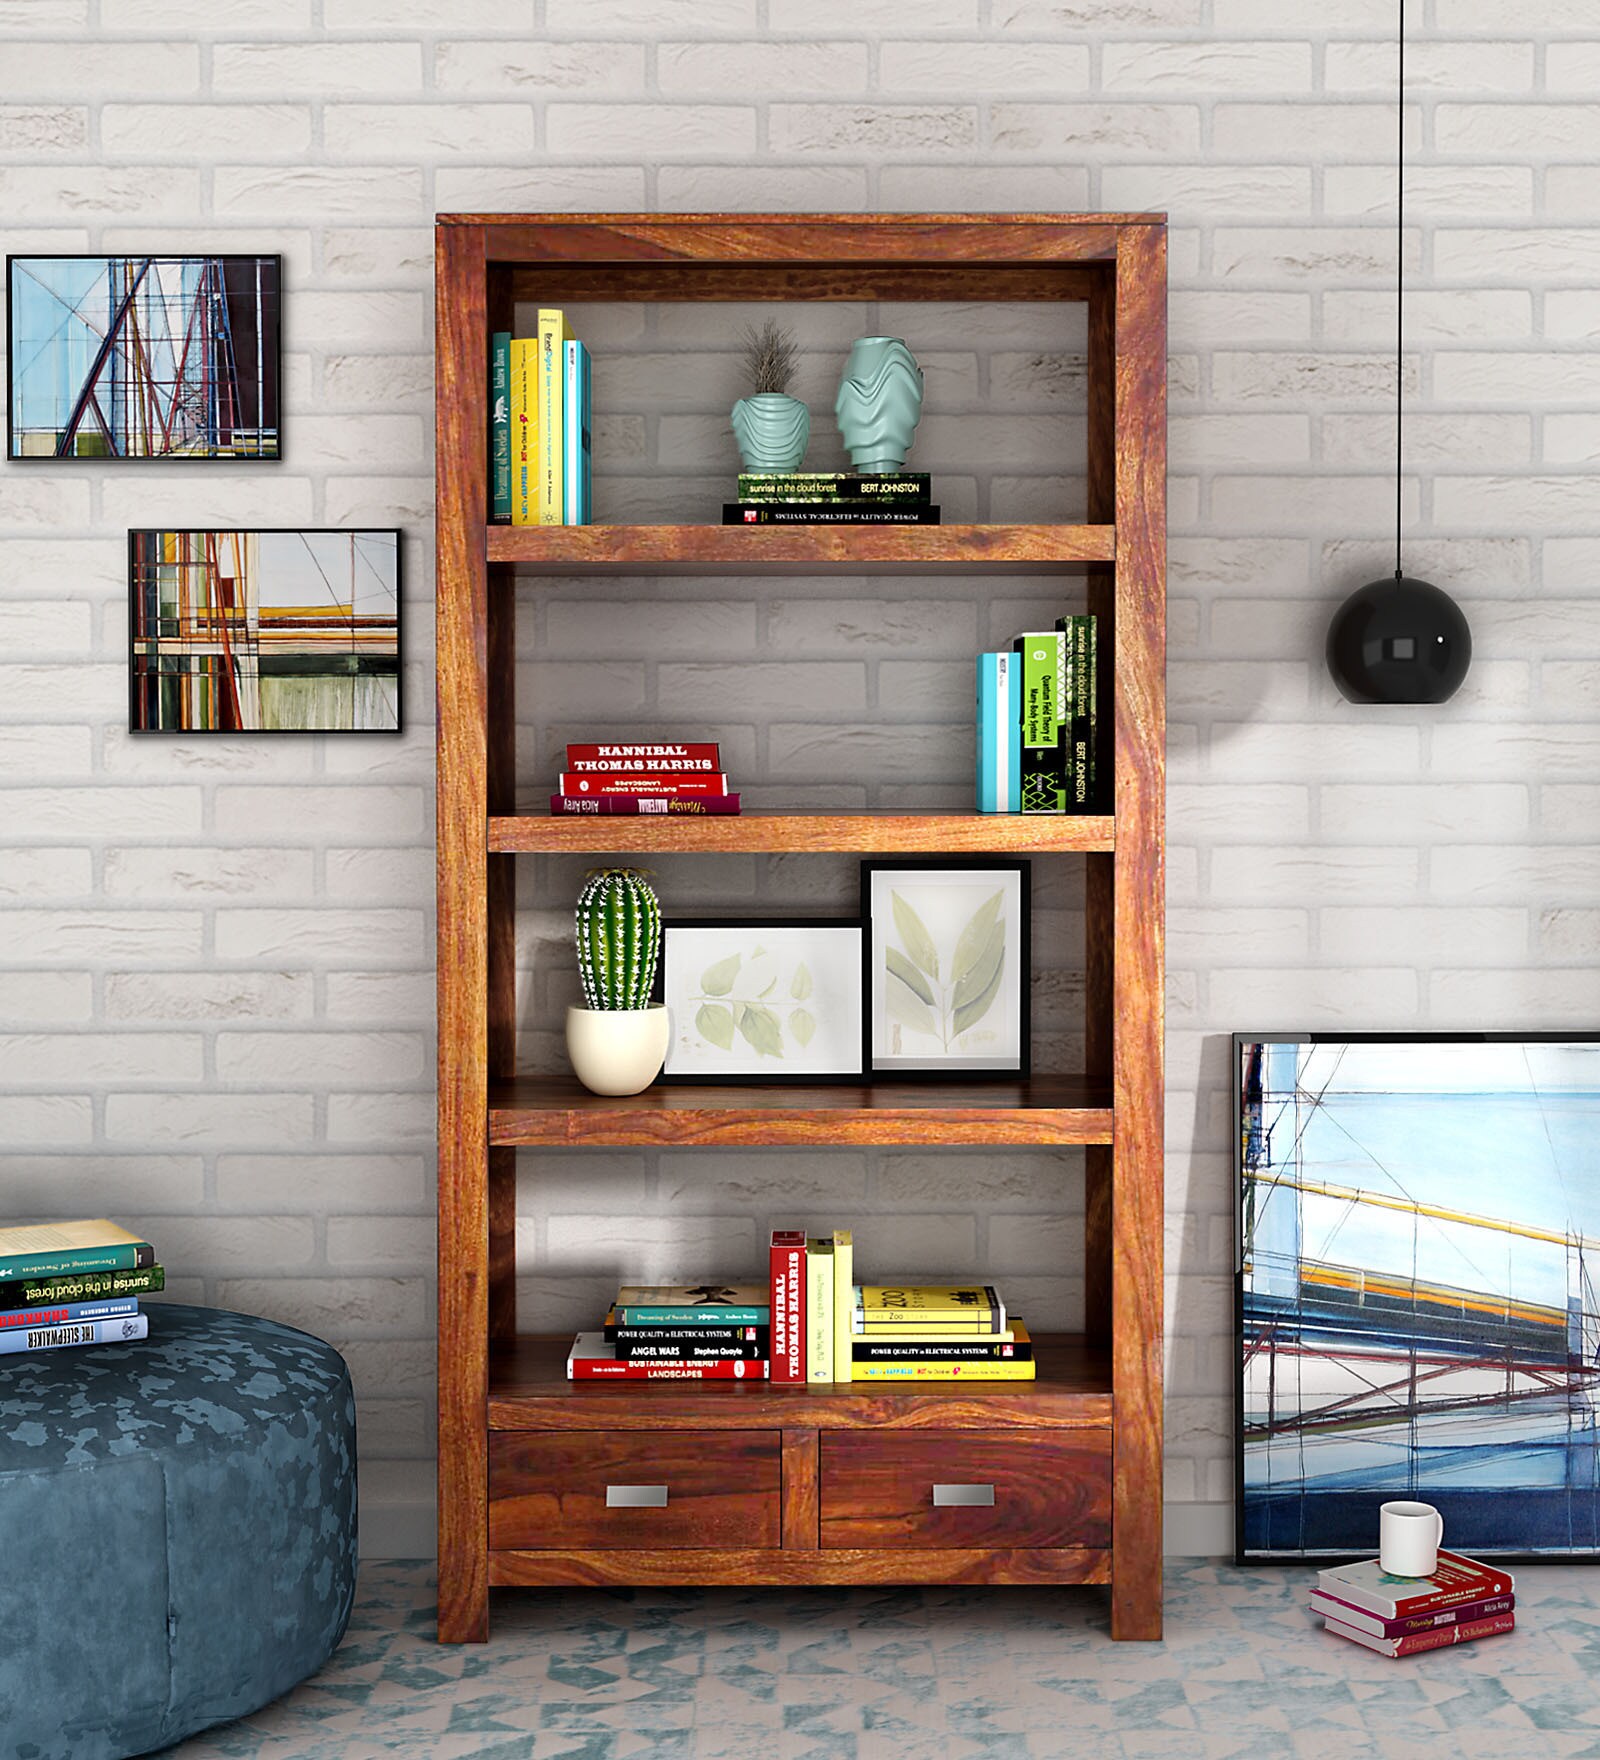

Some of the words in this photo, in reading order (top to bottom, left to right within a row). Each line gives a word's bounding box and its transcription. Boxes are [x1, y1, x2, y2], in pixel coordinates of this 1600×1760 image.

[494, 348, 505, 367] Brown
[494, 367, 505, 390] Andrew
[494, 429, 509, 457] Sweden
[494, 465, 511, 501] Dreaming
[749, 483, 776, 493] sunrise
[777, 482, 784, 493] in
[784, 482, 795, 493] the
[796, 482, 815, 493] cloud
[816, 482, 837, 493] forest
[860, 483, 879, 493] BERT
[879, 483, 920, 493] JOHNSTON
[860, 512, 892, 521] QUALITY
[1077, 626, 1086, 653] sunrise
[1078, 661, 1087, 674] the
[1041, 675, 1052, 701] Quantum
[1078, 675, 1087, 694] cloud
[1042, 701, 1052, 715] Field
[1077, 695, 1087, 717] forest
[1028, 719, 1040, 743] Systems
[1040, 716, 1052, 735] Theory
[598, 746, 688, 757] HANNIBAL
[1076, 741, 1086, 760] BERT
[574, 760, 645, 771] THOMAS
[646, 759, 713, 770] HARRIS
[1076, 760, 1086, 802] JOHNSTON
[563, 798, 581, 813] Airey
[581, 800, 600, 813] Alicia
[22, 1264, 59, 1273] Sweden
[71, 1258, 117, 1268] Dreaming
[85, 1283, 101, 1294] the
[102, 1281, 112, 1292] in
[113, 1276, 149, 1290] sunrise
[788, 1252, 799, 1312] HARRIS
[26, 1287, 55, 1301] forest
[55, 1284, 84, 1298] cloud
[882, 1290, 907, 1307] ZOO
[776, 1273, 786, 1355] HANNIBAL
[889, 1312, 904, 1320] Zoo
[27, 1326, 79, 1349] SLEEPWALKER
[81, 1325, 95, 1343] THE
[617, 1330, 638, 1338] POWER
[638, 1330, 664, 1339] QUALITY
[670, 1330, 705, 1338] ELECTRICAL
[706, 1330, 732, 1338] SYSTEMS
[631, 1347, 658, 1356] ANGEL
[658, 1347, 680, 1356] WARS
[694, 1347, 719, 1357] Stephen
[719, 1347, 743, 1356] Quayle
[788, 1313, 799, 1378] THOMAS
[628, 1360, 685, 1368] SUSTAINABLE
[647, 1370, 703, 1378] LANDSCAPES
